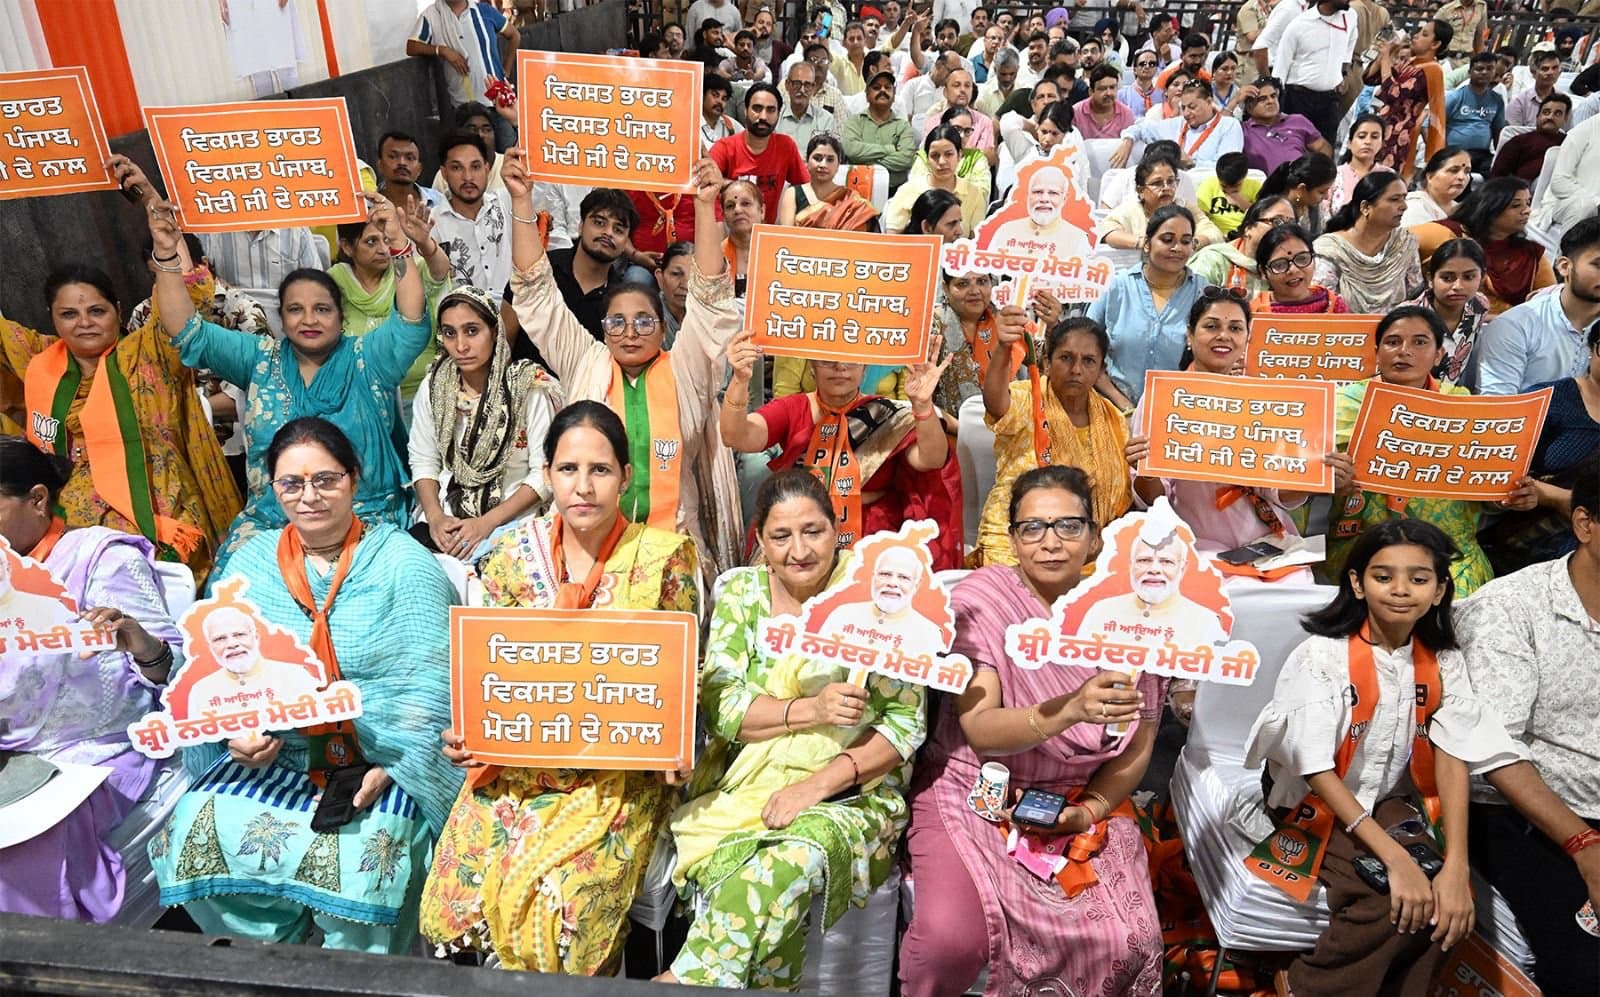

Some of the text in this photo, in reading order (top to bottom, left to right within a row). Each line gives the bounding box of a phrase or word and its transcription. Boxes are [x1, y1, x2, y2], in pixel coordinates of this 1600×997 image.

[544, 75, 673, 108] ਵਿਕਸਤ ਭਾਰਤ
[0, 96, 63, 118] ਭਾਰਤ
[3, 125, 79, 149] ਪੰਜਾਬ,
[181, 126, 322, 152] ਵਿਕਸਤ ਭਾਰਤ
[541, 108, 677, 144] ਵਿਕਸਤ ਪੰਜਾਬ,
[13, 156, 34, 178] ਦੇ
[38, 157, 87, 176] ਨਾਲ
[185, 154, 334, 184] ਵਿਕਸਤ ਪੰਜਾਬ,
[542, 139, 676, 174] ਮੋਦੀ ਜੀ ਦੇ ਨਾਲ
[195, 186, 339, 215] ਮੋਦੀ ਜੀ ਦੇ ਨਾਲ
[1006, 238, 1015, 247] ਜੀ
[775, 247, 911, 282] ਵਿਕਸਤ ਭਾਰਤ
[1041, 255, 1082, 278] ਮੋਦੀ
[1086, 259, 1109, 286] ਜੀ
[768, 281, 910, 318] ਵਿਕਸਤ ਪੰਜਾਬ,
[766, 312, 909, 346] ਮੋਦੀ ਜੀ ਦੇ ਨਾਲ
[1265, 328, 1367, 347] ਵਿਕਸਤ ਭਾਰਤ
[1258, 351, 1365, 372] ਵਿਕਸਤ ਪੰਜਾਬ,
[1172, 388, 1304, 417] ਵਿਕਸਤ ਭਾਰਤ
[1166, 414, 1308, 447] ਵਿਕਸਤ ਪੰਜਾਬ,
[1389, 404, 1527, 435] ਵਿਕਸਤ ਭਾਰਤ
[813, 449, 827, 465] P
[840, 451, 849, 467] B
[1164, 440, 1307, 473] ਮੋਦੀ ਜੀ ਦੇ ਨਾਲ
[1375, 430, 1518, 462] ਵਿਕਸਤ ਪੰਜਾਬ,
[1367, 455, 1512, 486] ਮੋਦੀ ਜੀ ਦੇ ਨਾਲ
[840, 506, 848, 523] J
[15, 625, 72, 651] ਮੋਦੀ
[843, 623, 854, 635] ਜੀ
[1103, 620, 1117, 633] ਜੀ
[487, 632, 661, 667] ਵਿਕਸਤ ਭਾਰਤ
[1156, 640, 1214, 674] ਮੋਦੀ
[1221, 647, 1257, 679] ਜੀ
[883, 651, 933, 679] ਮੋਦੀ
[938, 661, 968, 688] ਜੀ
[208, 695, 222, 707] ਜੀ
[266, 694, 318, 723] ਮੋਦੀ
[325, 687, 355, 715] ਜੀ
[481, 672, 663, 709] ਵਿਕਸਤ ਪੰਜਾਬ,
[481, 710, 663, 745] ਮੋਦੀ ਜੀ ਦੇ ਨਾਲ
[1295, 803, 1317, 823] P
[1258, 861, 1299, 881] BJP
